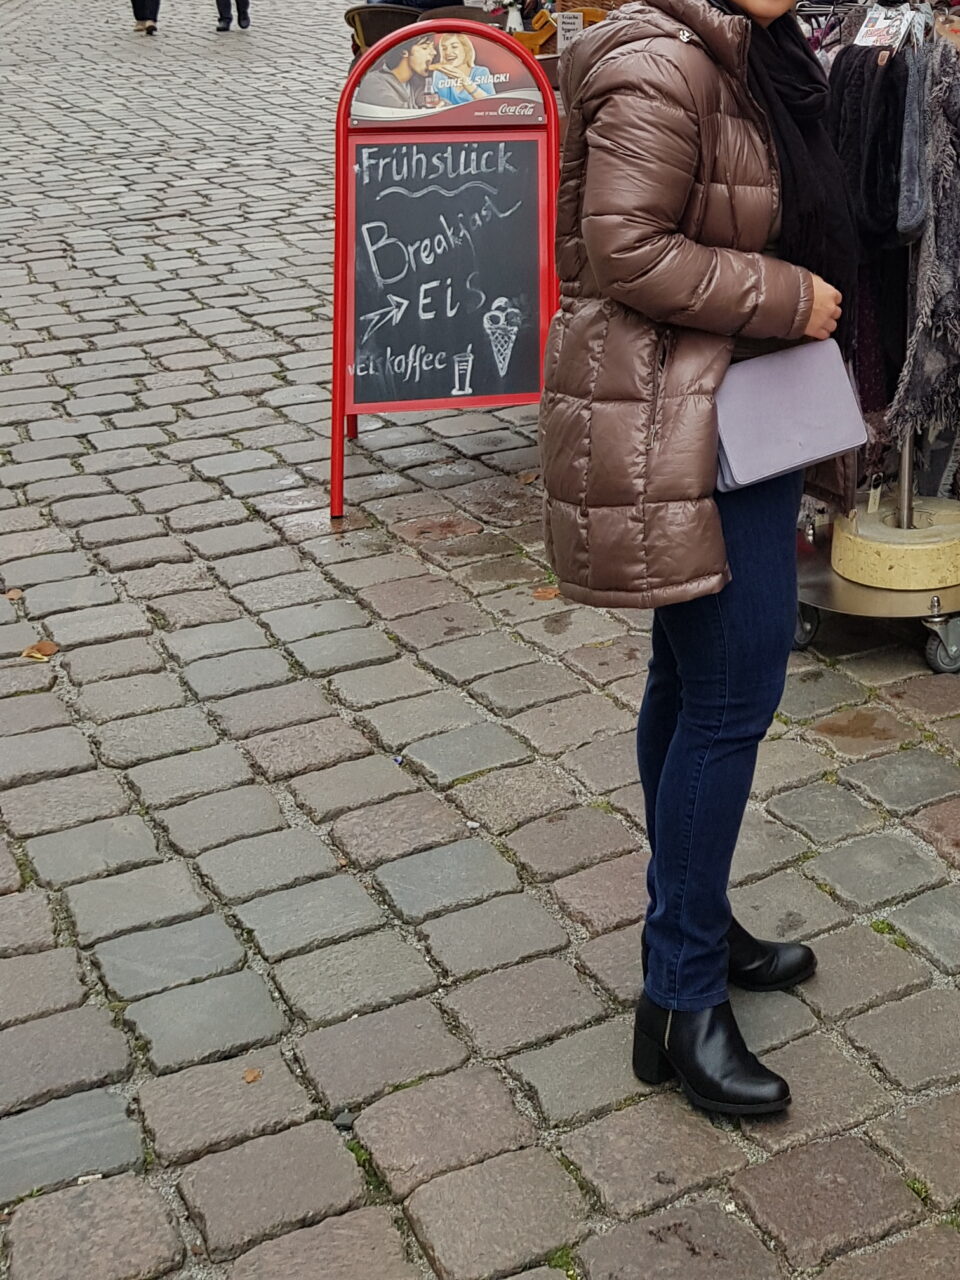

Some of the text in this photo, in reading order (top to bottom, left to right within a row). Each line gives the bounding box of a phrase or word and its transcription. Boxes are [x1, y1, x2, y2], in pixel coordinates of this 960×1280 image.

[438, 78, 462, 89] COKE
[475, 73, 510, 85] SNACK!
[361, 142, 517, 186] Frühstück
[418, 271, 487, 320] Eis
